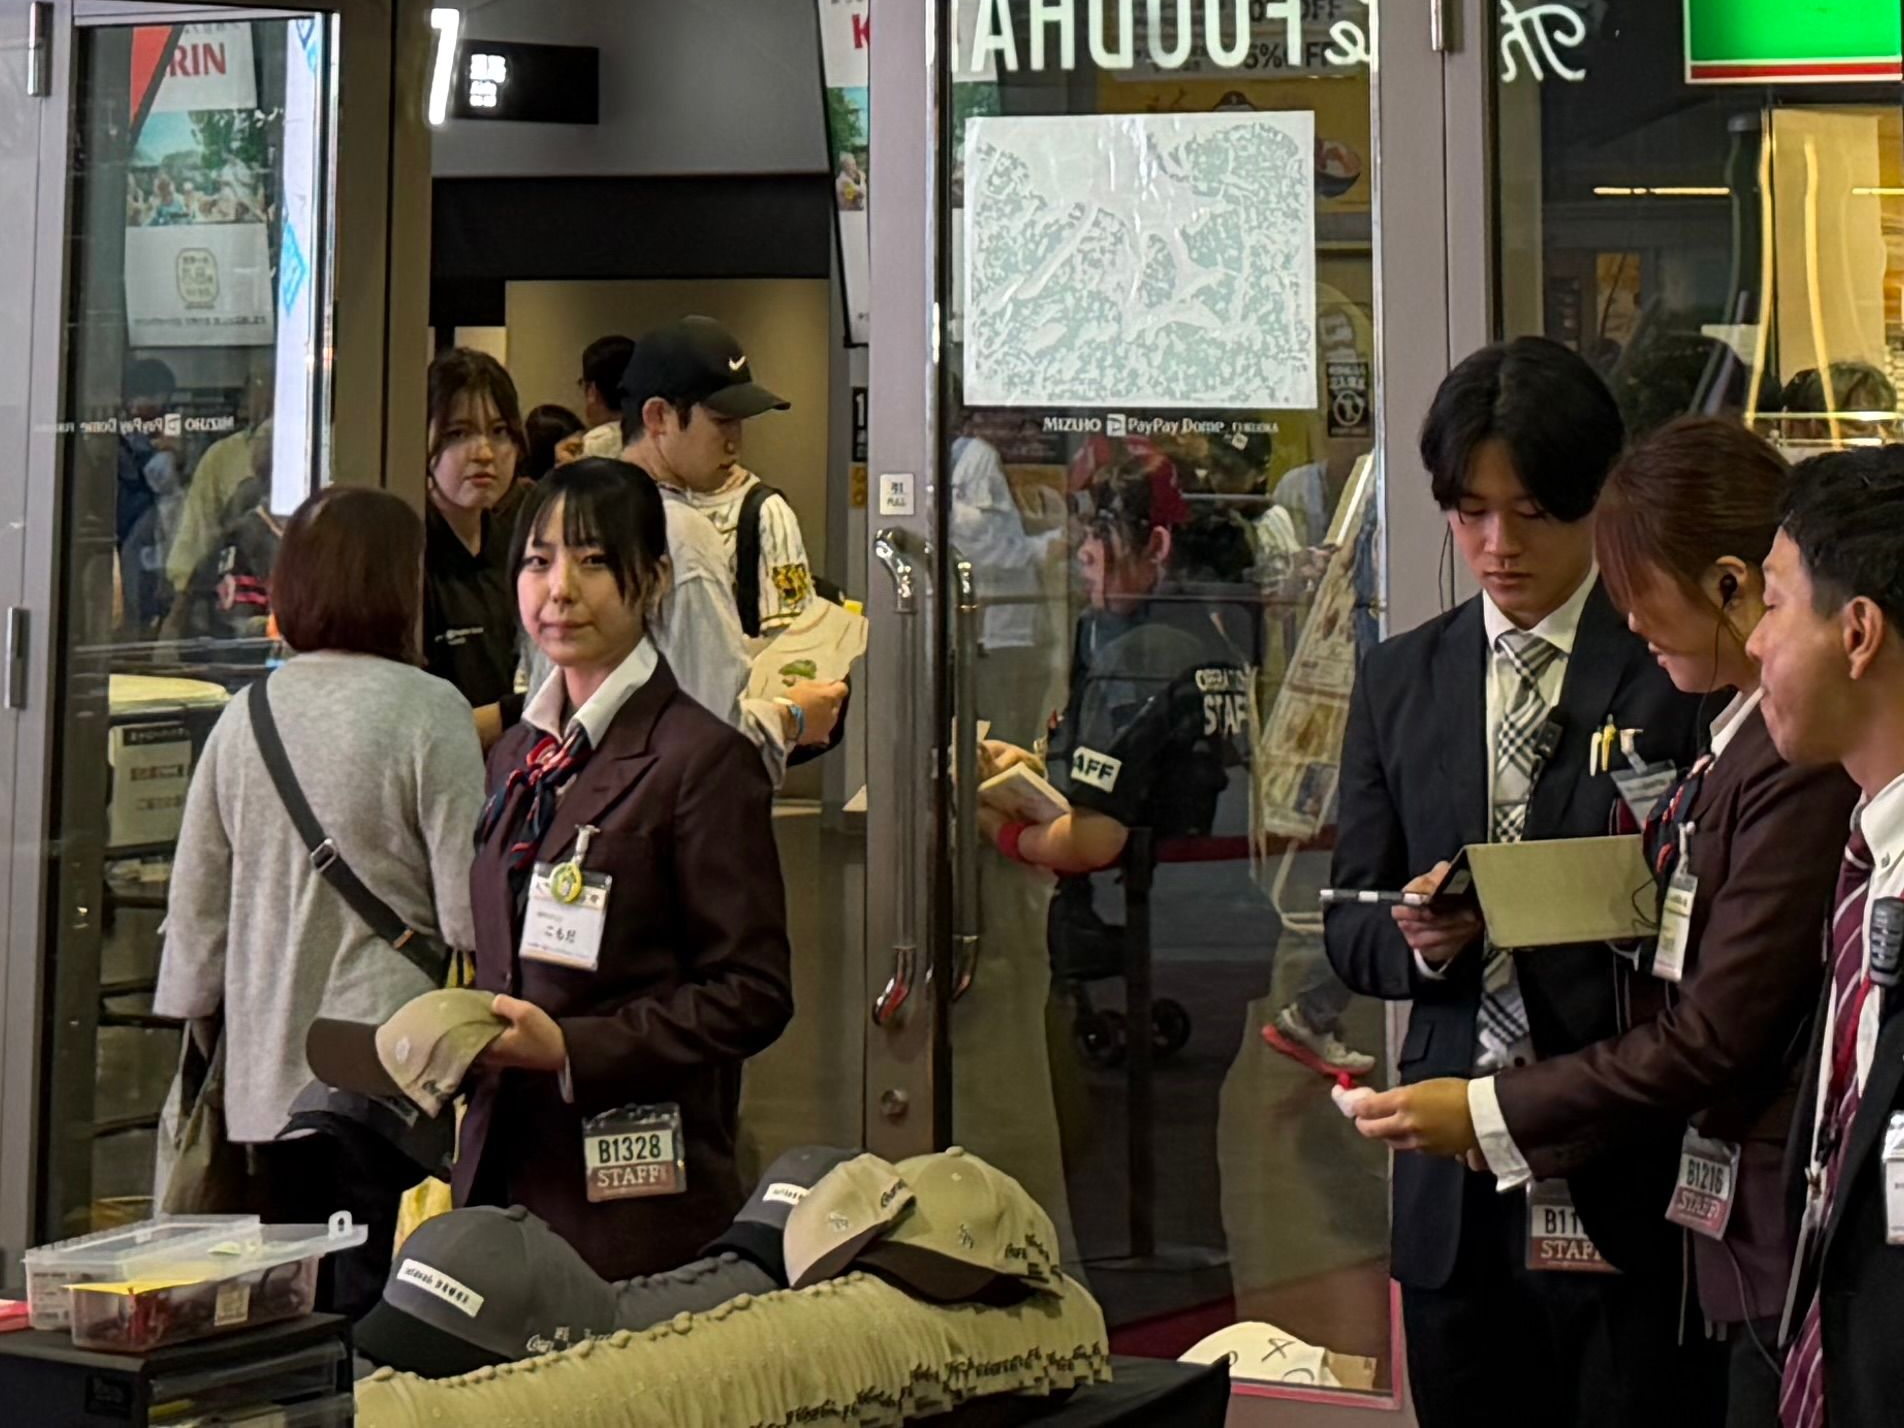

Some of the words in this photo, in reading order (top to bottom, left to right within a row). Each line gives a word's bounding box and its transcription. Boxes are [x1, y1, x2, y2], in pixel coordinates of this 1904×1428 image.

[1127, 417, 1179, 436] PayPay
[1203, 694, 1250, 737] STAF
[1073, 752, 1115, 781] AFF
[597, 1133, 661, 1164] B1328
[597, 1164, 661, 1188] STAFF
